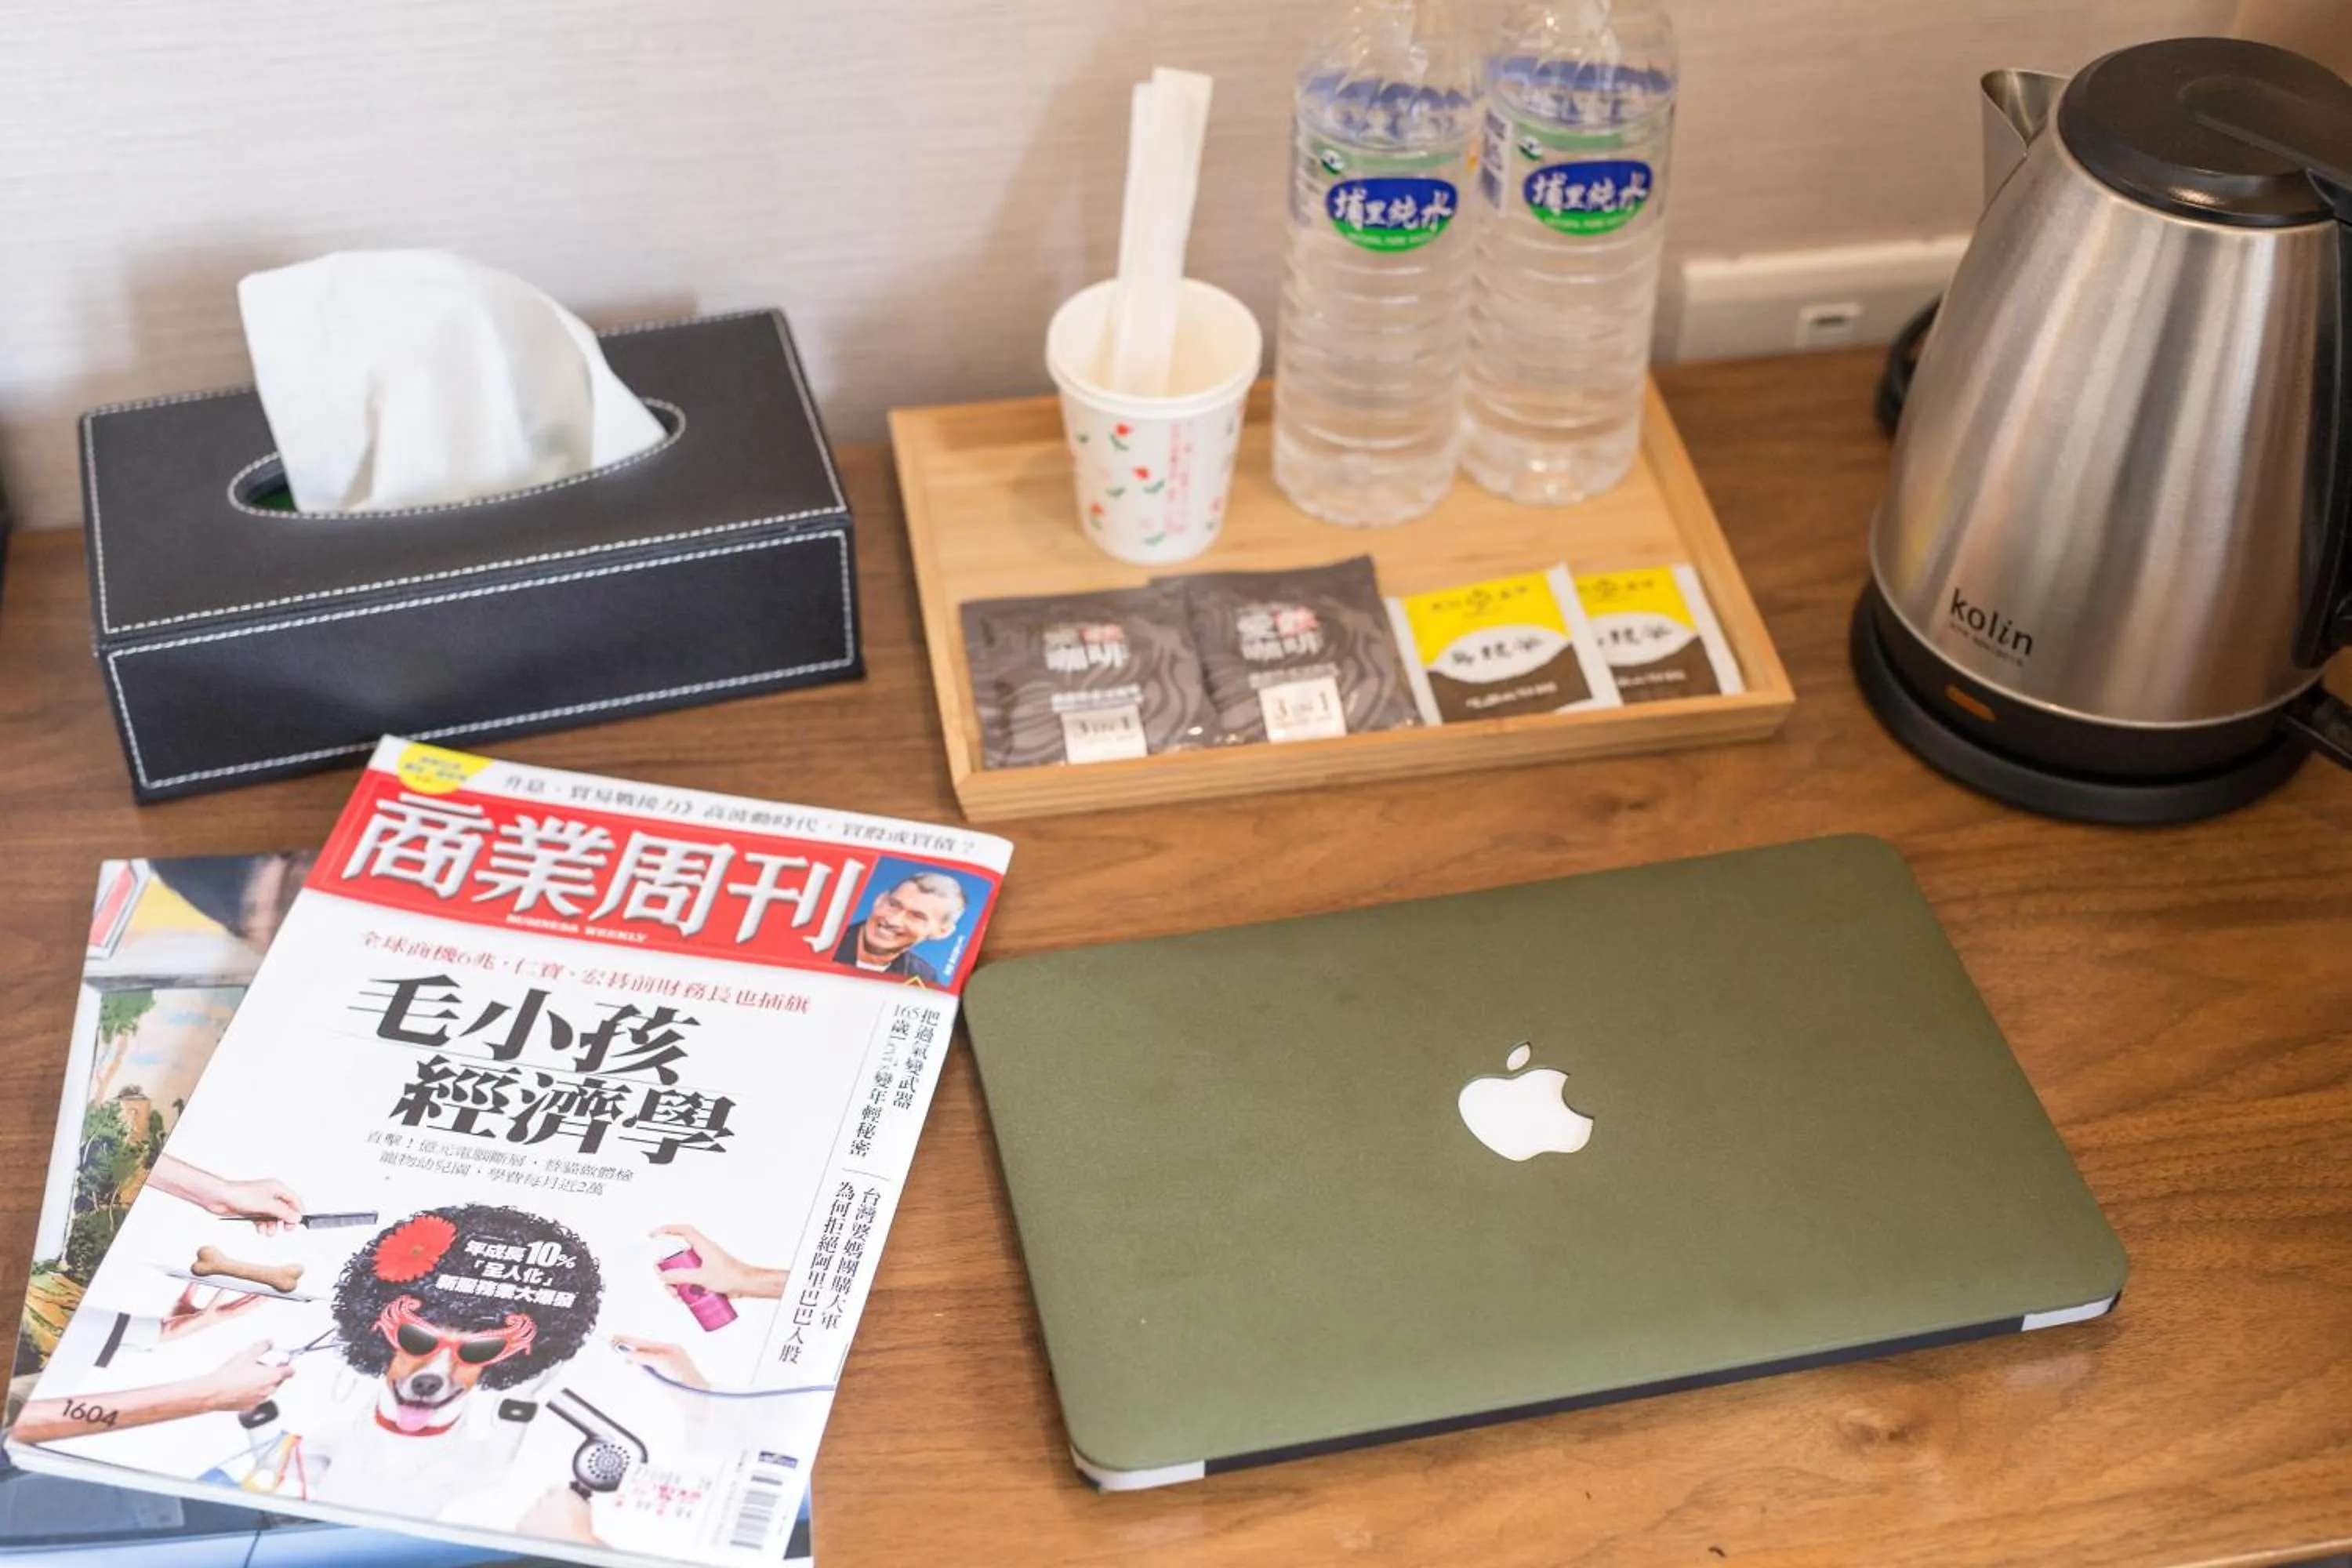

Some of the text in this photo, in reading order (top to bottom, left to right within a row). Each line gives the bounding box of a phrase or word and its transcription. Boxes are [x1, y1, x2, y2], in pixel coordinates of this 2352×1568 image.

[1333, 187, 1453, 232] 埔里純水
[1530, 169, 1649, 217] 埔里純水
[1950, 586, 2034, 656] kolin
[342, 791, 866, 952] 商業周刊
[506, 913, 648, 943] BUSINESS WEEKLY
[347, 975, 700, 1087] 毛小孩
[892, 1007, 941, 1111] 把過氣變武器
[390, 1054, 736, 1165] 經濟學
[779, 1181, 856, 1364] 為何拒絕阿里巴巴入股
[821, 1187, 881, 1331] 台灣婆媽團購大軍
[62, 1398, 118, 1428] 1604
